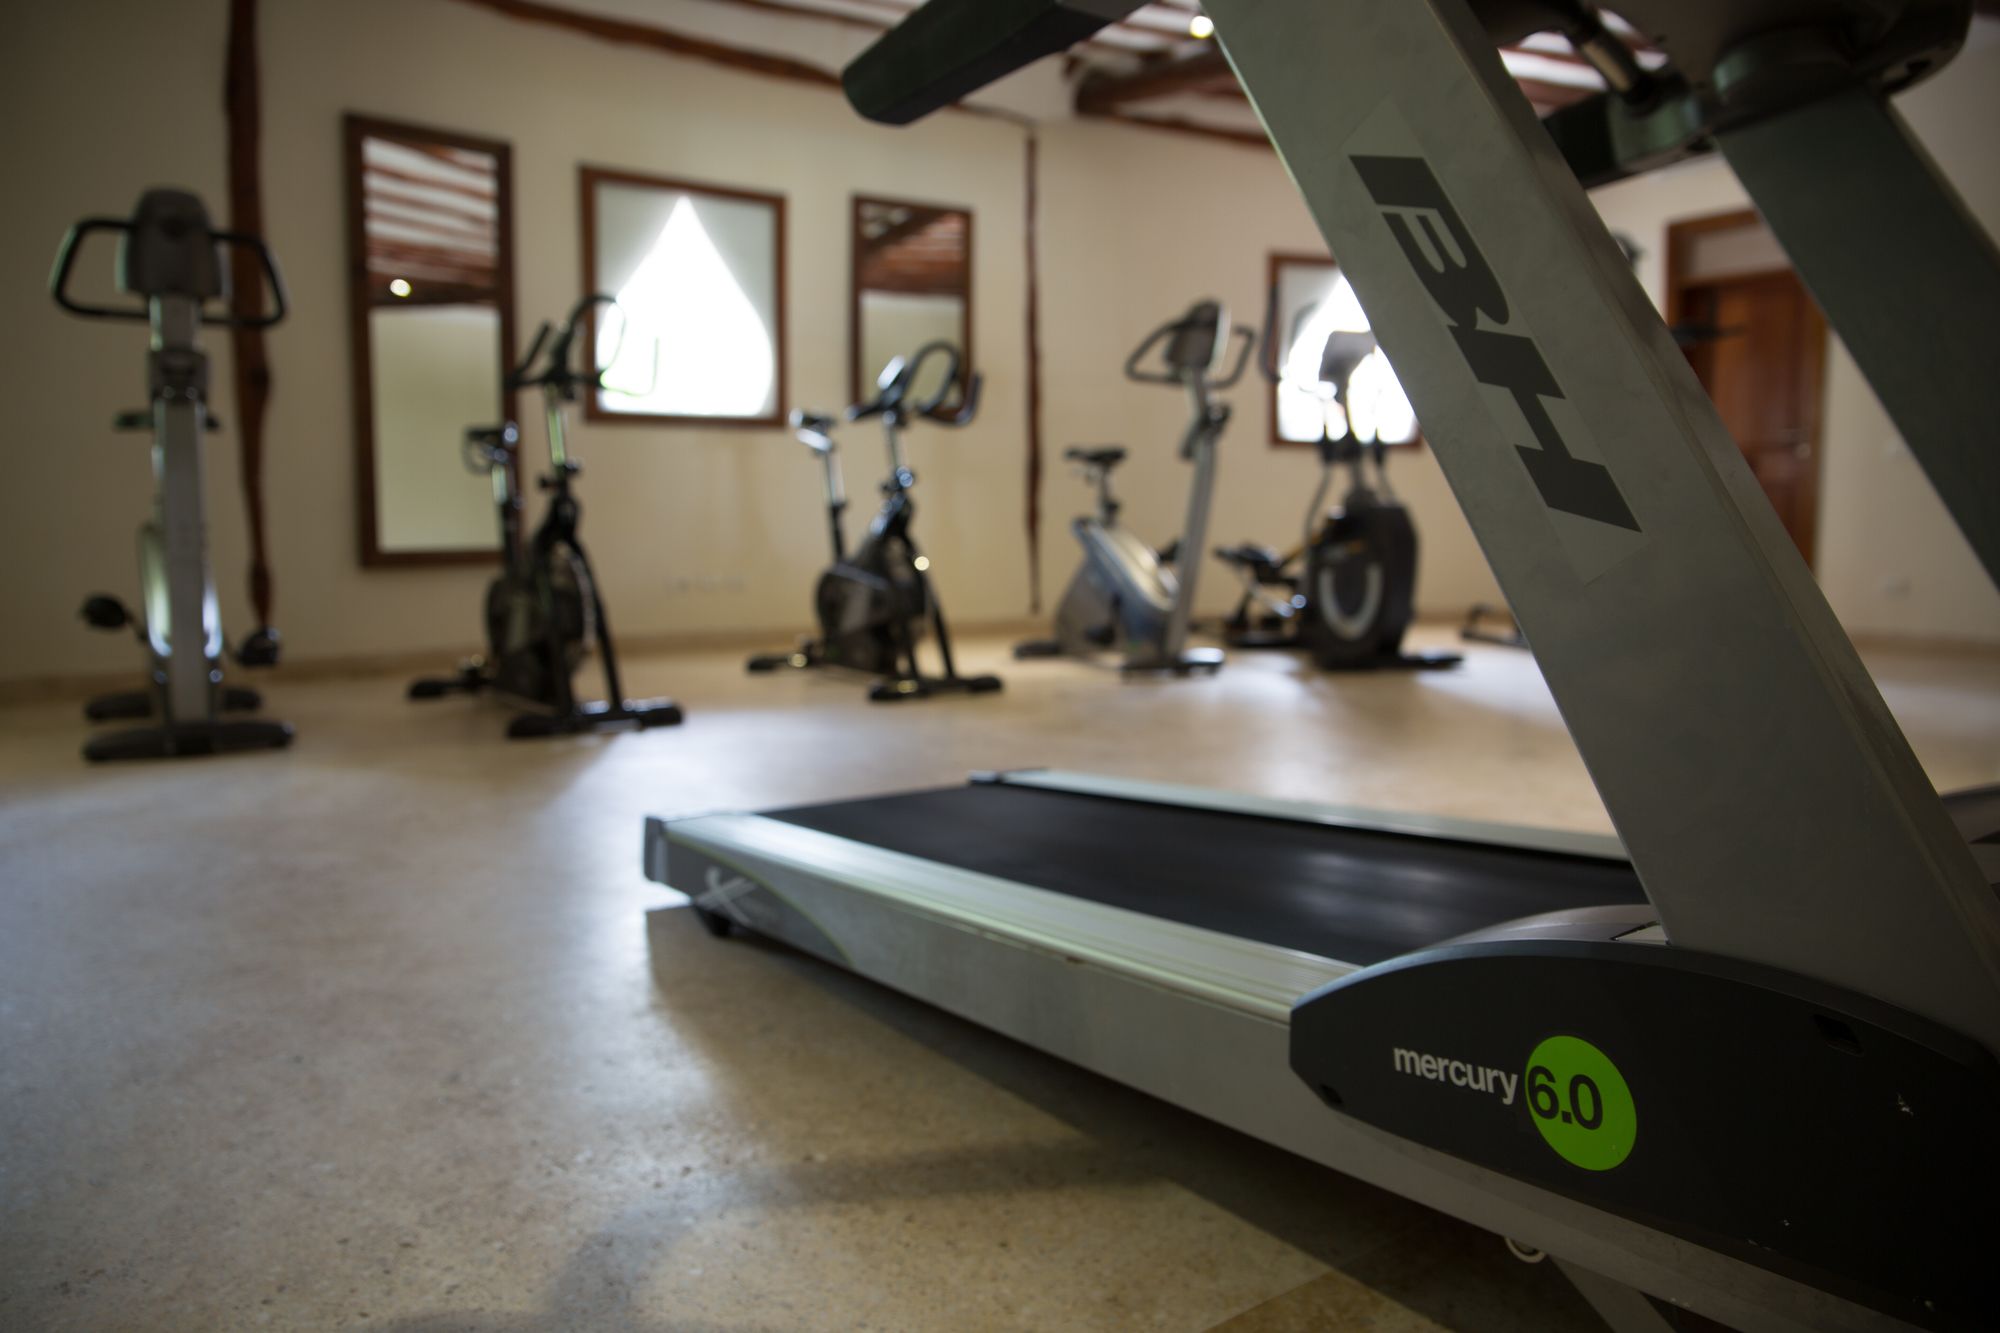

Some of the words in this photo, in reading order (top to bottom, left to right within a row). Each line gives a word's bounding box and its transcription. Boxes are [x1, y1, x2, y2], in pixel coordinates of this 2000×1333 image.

[1349, 155, 1642, 532] BH
[1393, 1047, 1518, 1105] mercury
[1528, 1065, 1603, 1130] 6.0
